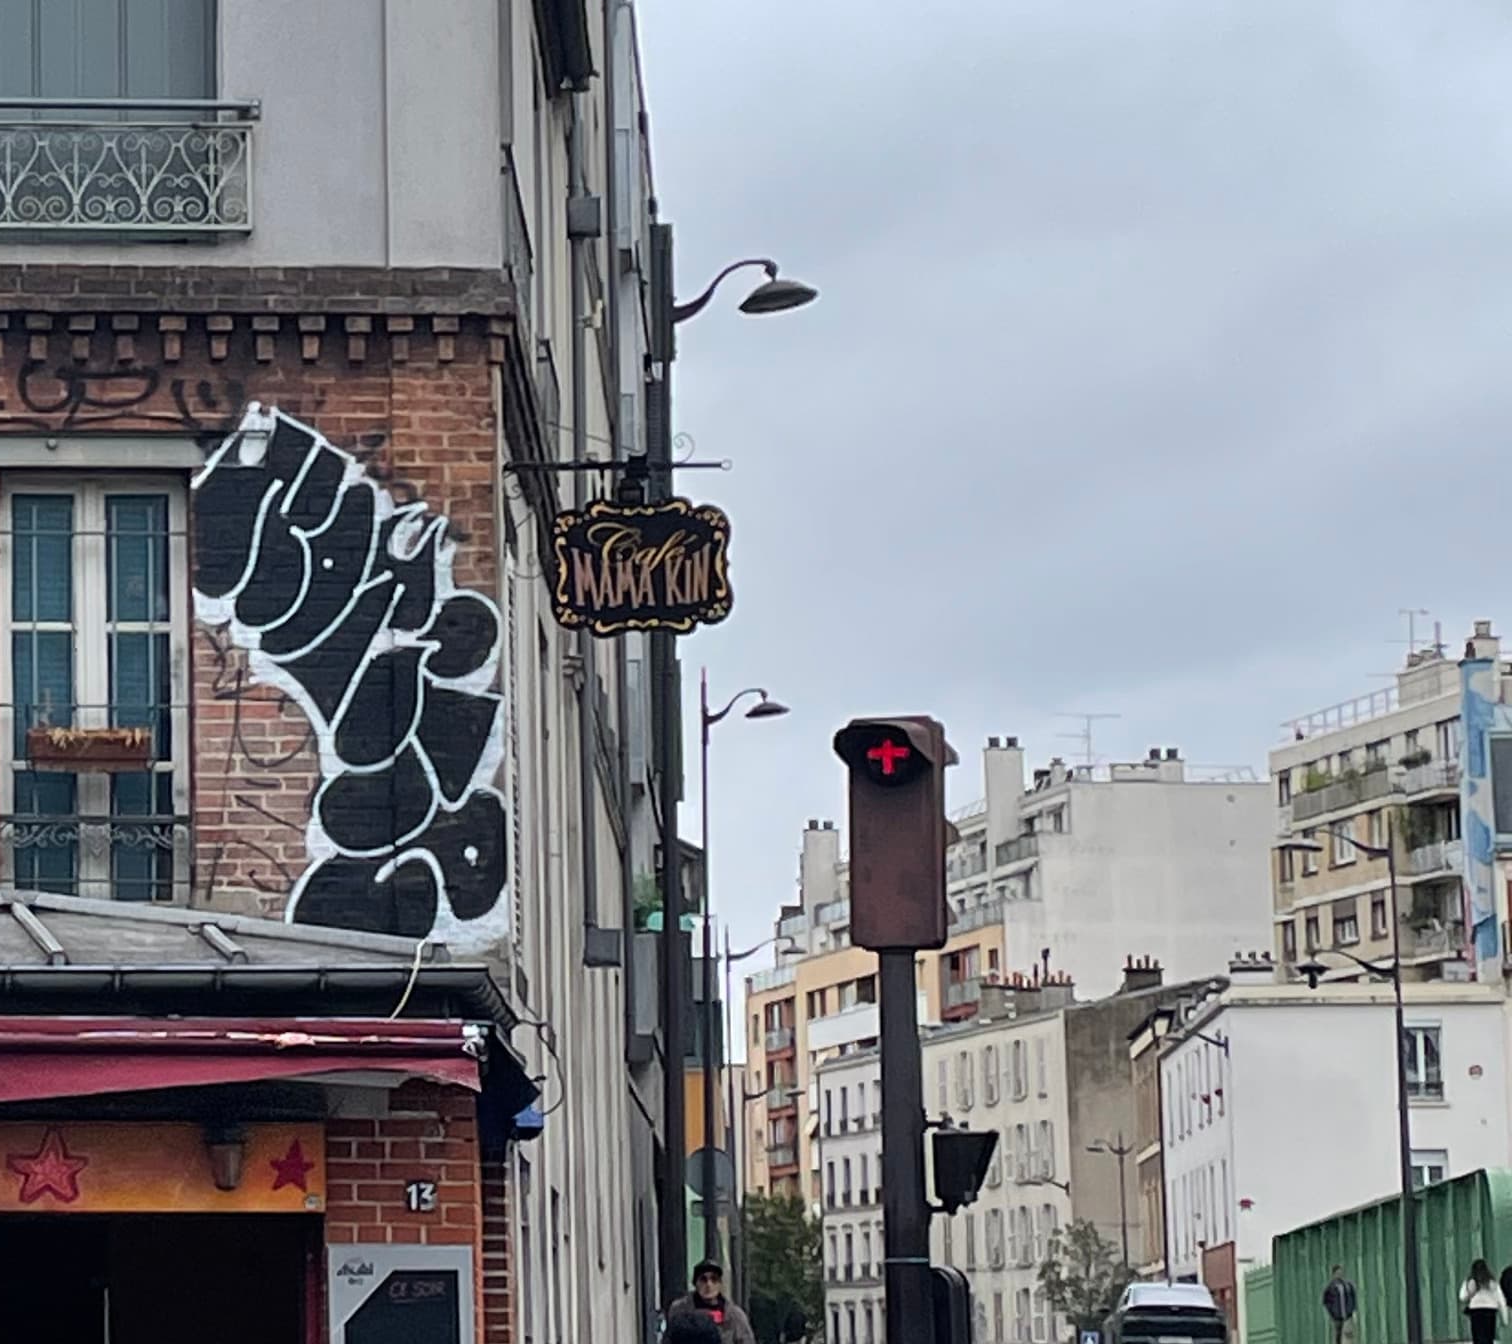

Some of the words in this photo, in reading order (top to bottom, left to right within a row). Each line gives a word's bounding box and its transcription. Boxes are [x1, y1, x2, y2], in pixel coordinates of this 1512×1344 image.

[587, 522, 696, 571] Café
[571, 547, 655, 611] MAMA
[665, 542, 711, 607] KIN
[406, 1182, 437, 1211] 13
